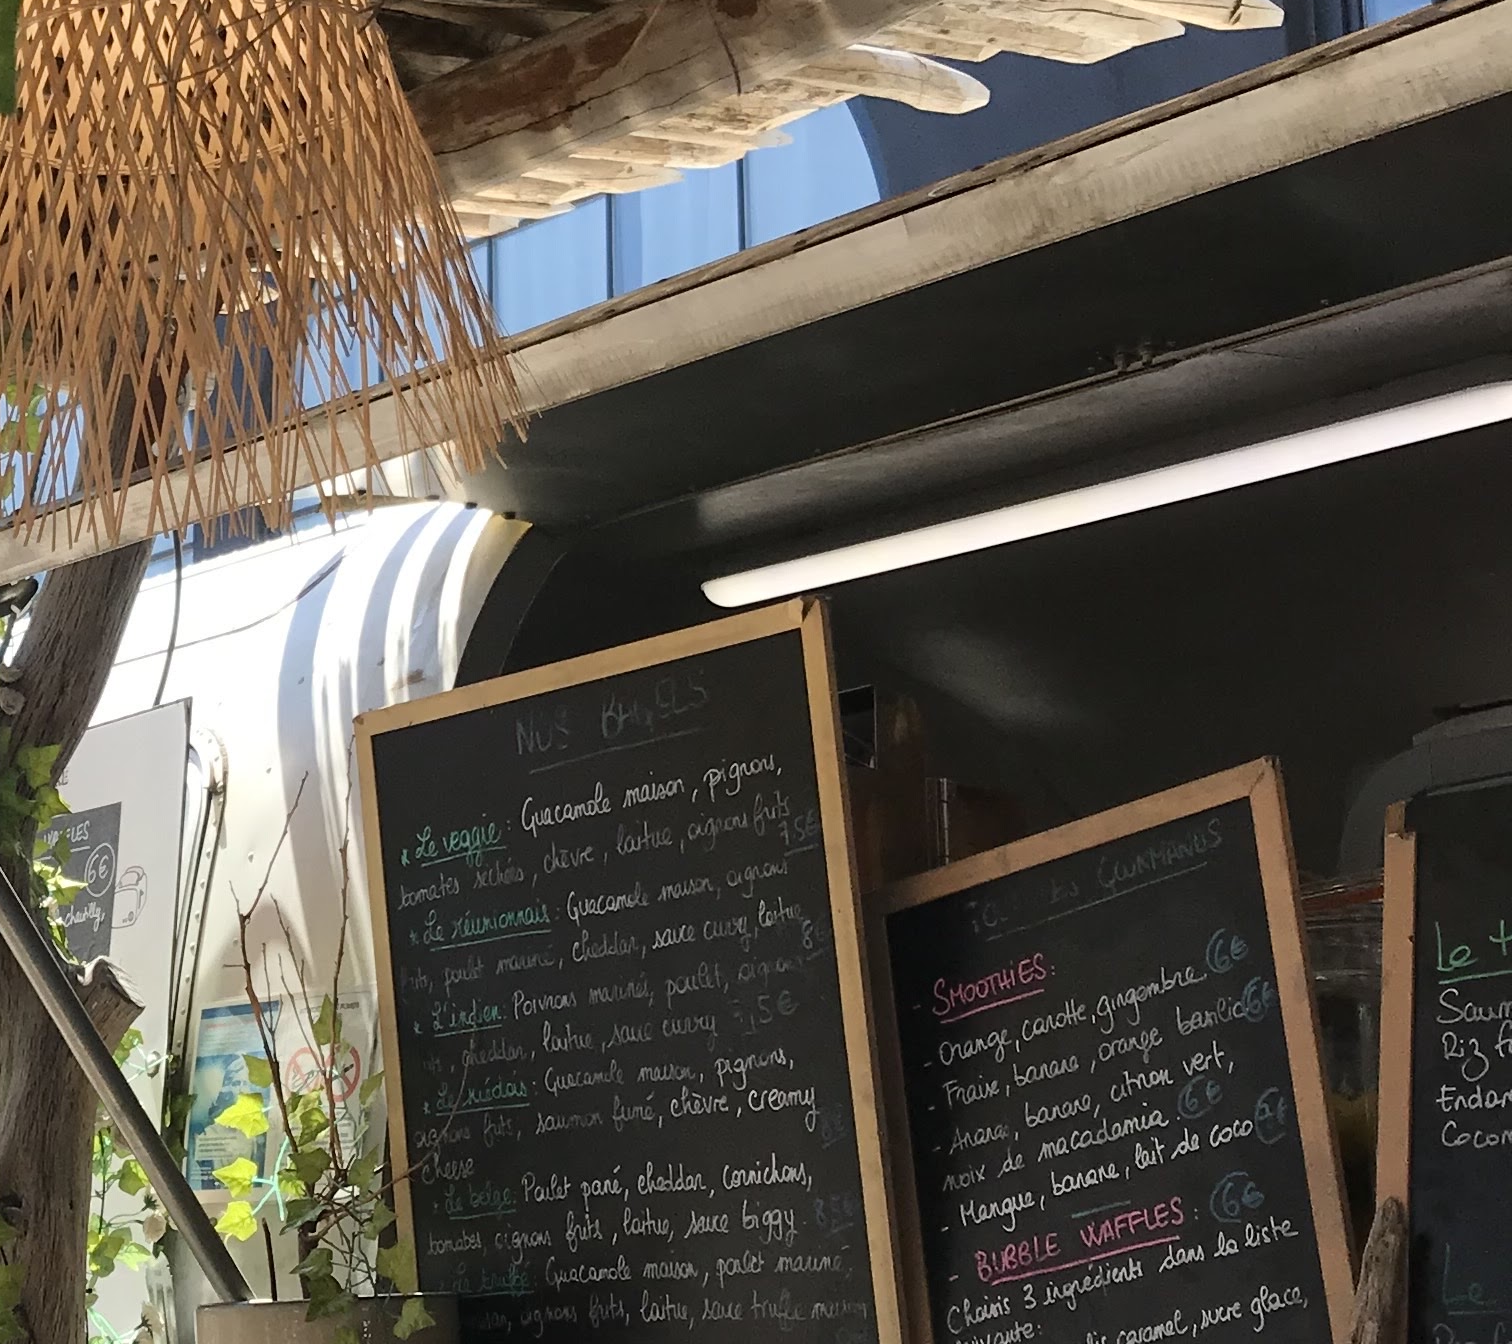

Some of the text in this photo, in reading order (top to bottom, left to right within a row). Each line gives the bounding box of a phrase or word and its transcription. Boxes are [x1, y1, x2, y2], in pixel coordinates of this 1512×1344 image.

[520, 781, 612, 838] Guacamole
[87, 853, 110, 886] 6€
[566, 881, 650, 927] Guacamole
[1434, 920, 1480, 973] Le
[511, 988, 578, 1021] Poivrons
[1098, 1026, 1163, 1065] orange
[543, 1058, 625, 1097] Guacamole
[1109, 1068, 1174, 1103] citron
[747, 1086, 820, 1133] creamy
[941, 1163, 987, 1193] noix
[996, 1148, 1026, 1179] de
[959, 1190, 1046, 1233] Mangue,
[1134, 1135, 1166, 1171] lait
[1170, 1127, 1201, 1161] de
[1209, 1118, 1255, 1149] coco
[741, 1198, 799, 1248] biggy
[544, 1254, 633, 1292] Guacamole
[974, 1231, 1063, 1284] BUBBLE
[1022, 1283, 1038, 1310] 3
[1042, 1256, 1144, 1311] ingrédients
[1158, 1243, 1206, 1273] dans
[1213, 1230, 1240, 1258] la
[1244, 1215, 1300, 1249] liste
[1200, 1301, 1243, 1331] sucre
